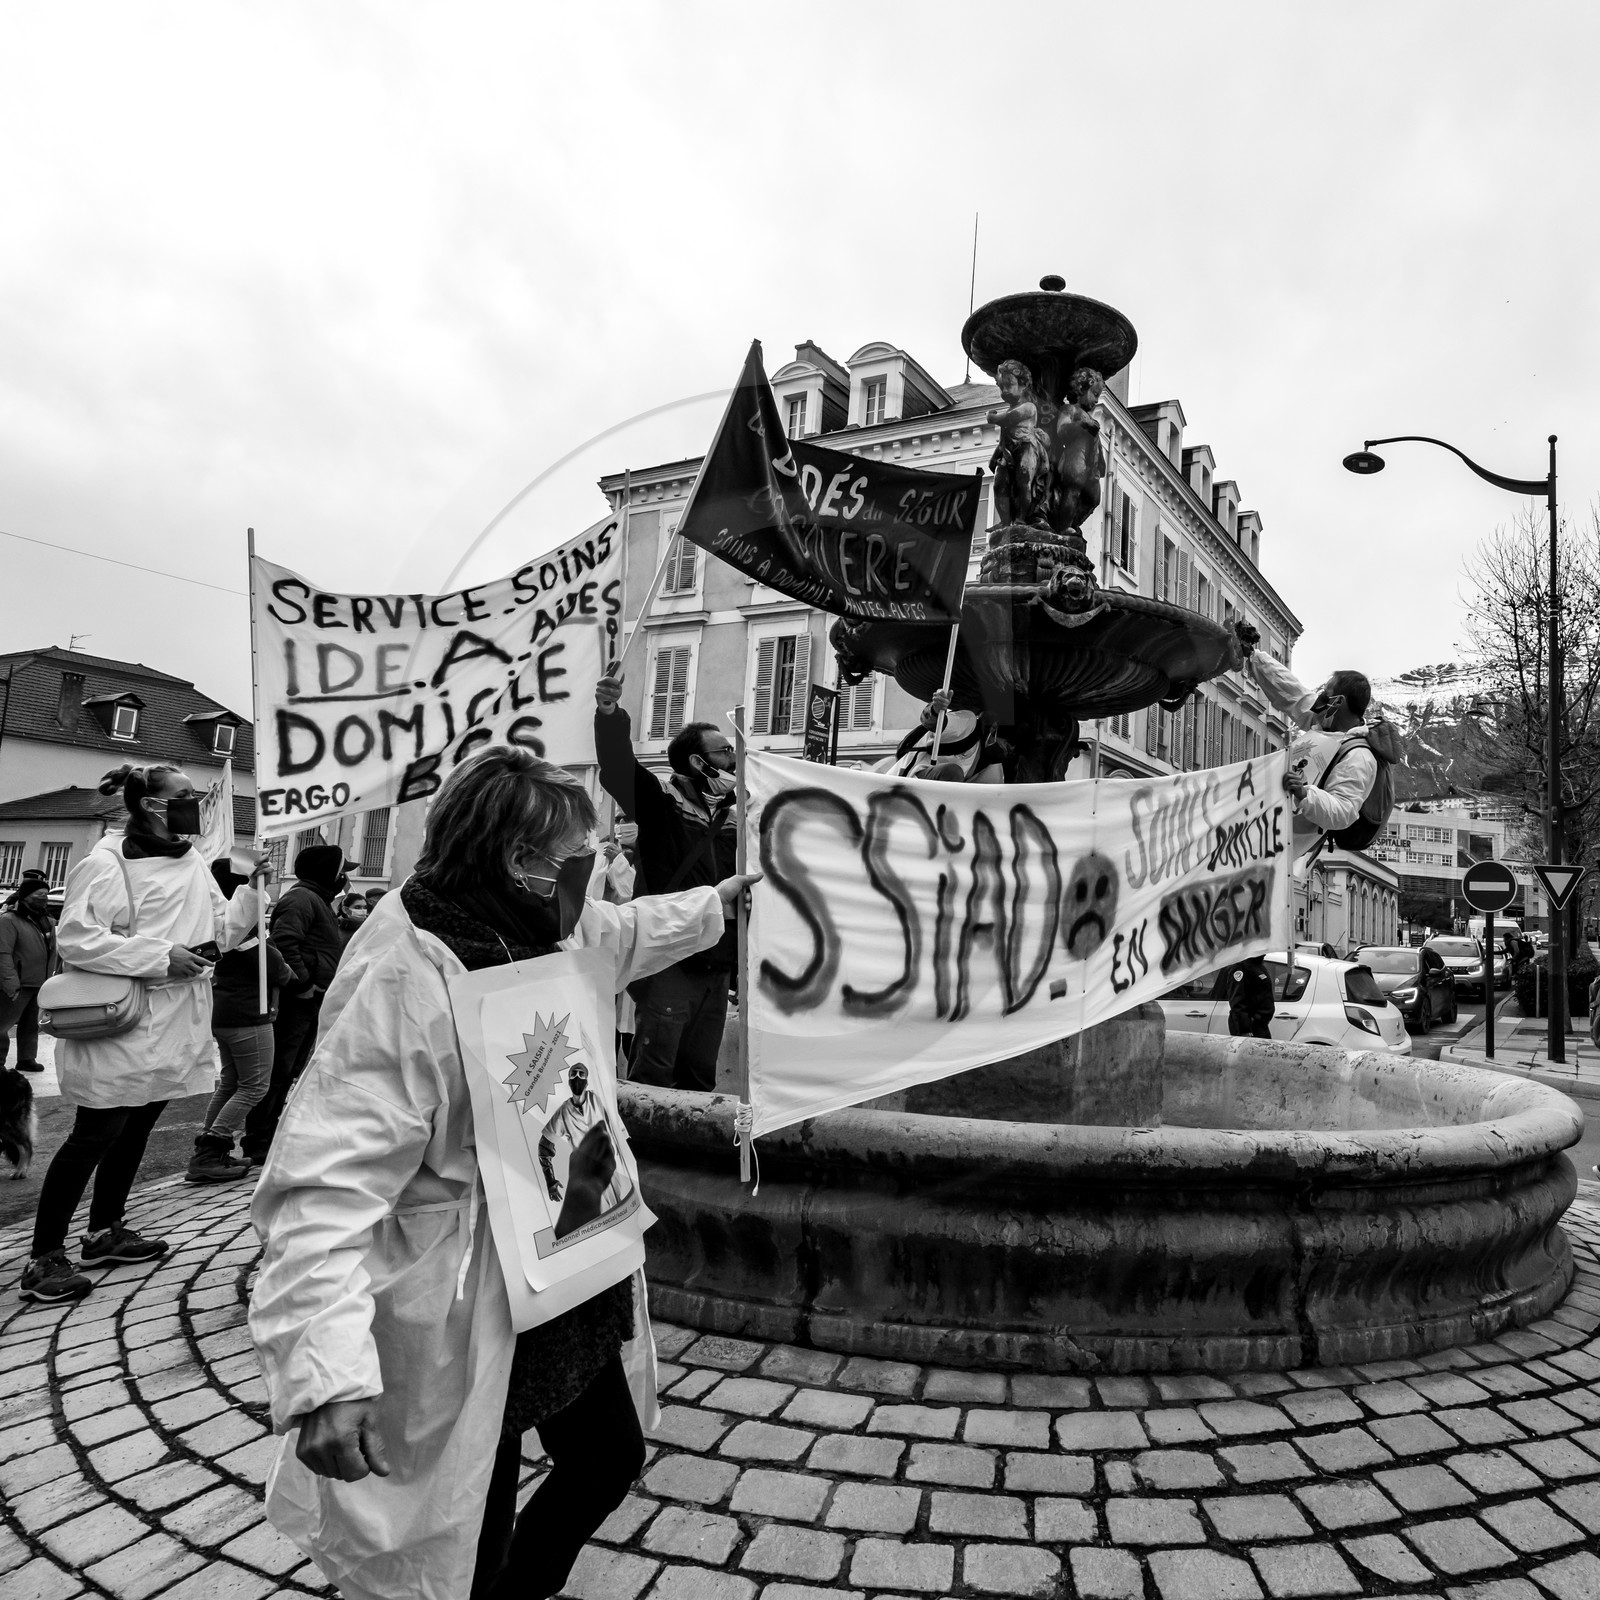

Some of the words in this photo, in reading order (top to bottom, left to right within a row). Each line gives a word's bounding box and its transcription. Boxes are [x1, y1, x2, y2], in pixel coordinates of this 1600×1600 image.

[1110, 918, 1148, 994] EN
[1158, 878, 1266, 971] DANGER
[524, 1073, 541, 1097] Grande
[538, 1047, 554, 1074] Braderie
[552, 1030, 561, 1046] 2021
[529, 1045, 545, 1070] SAISIR
[551, 1230, 581, 1249] Personnel
